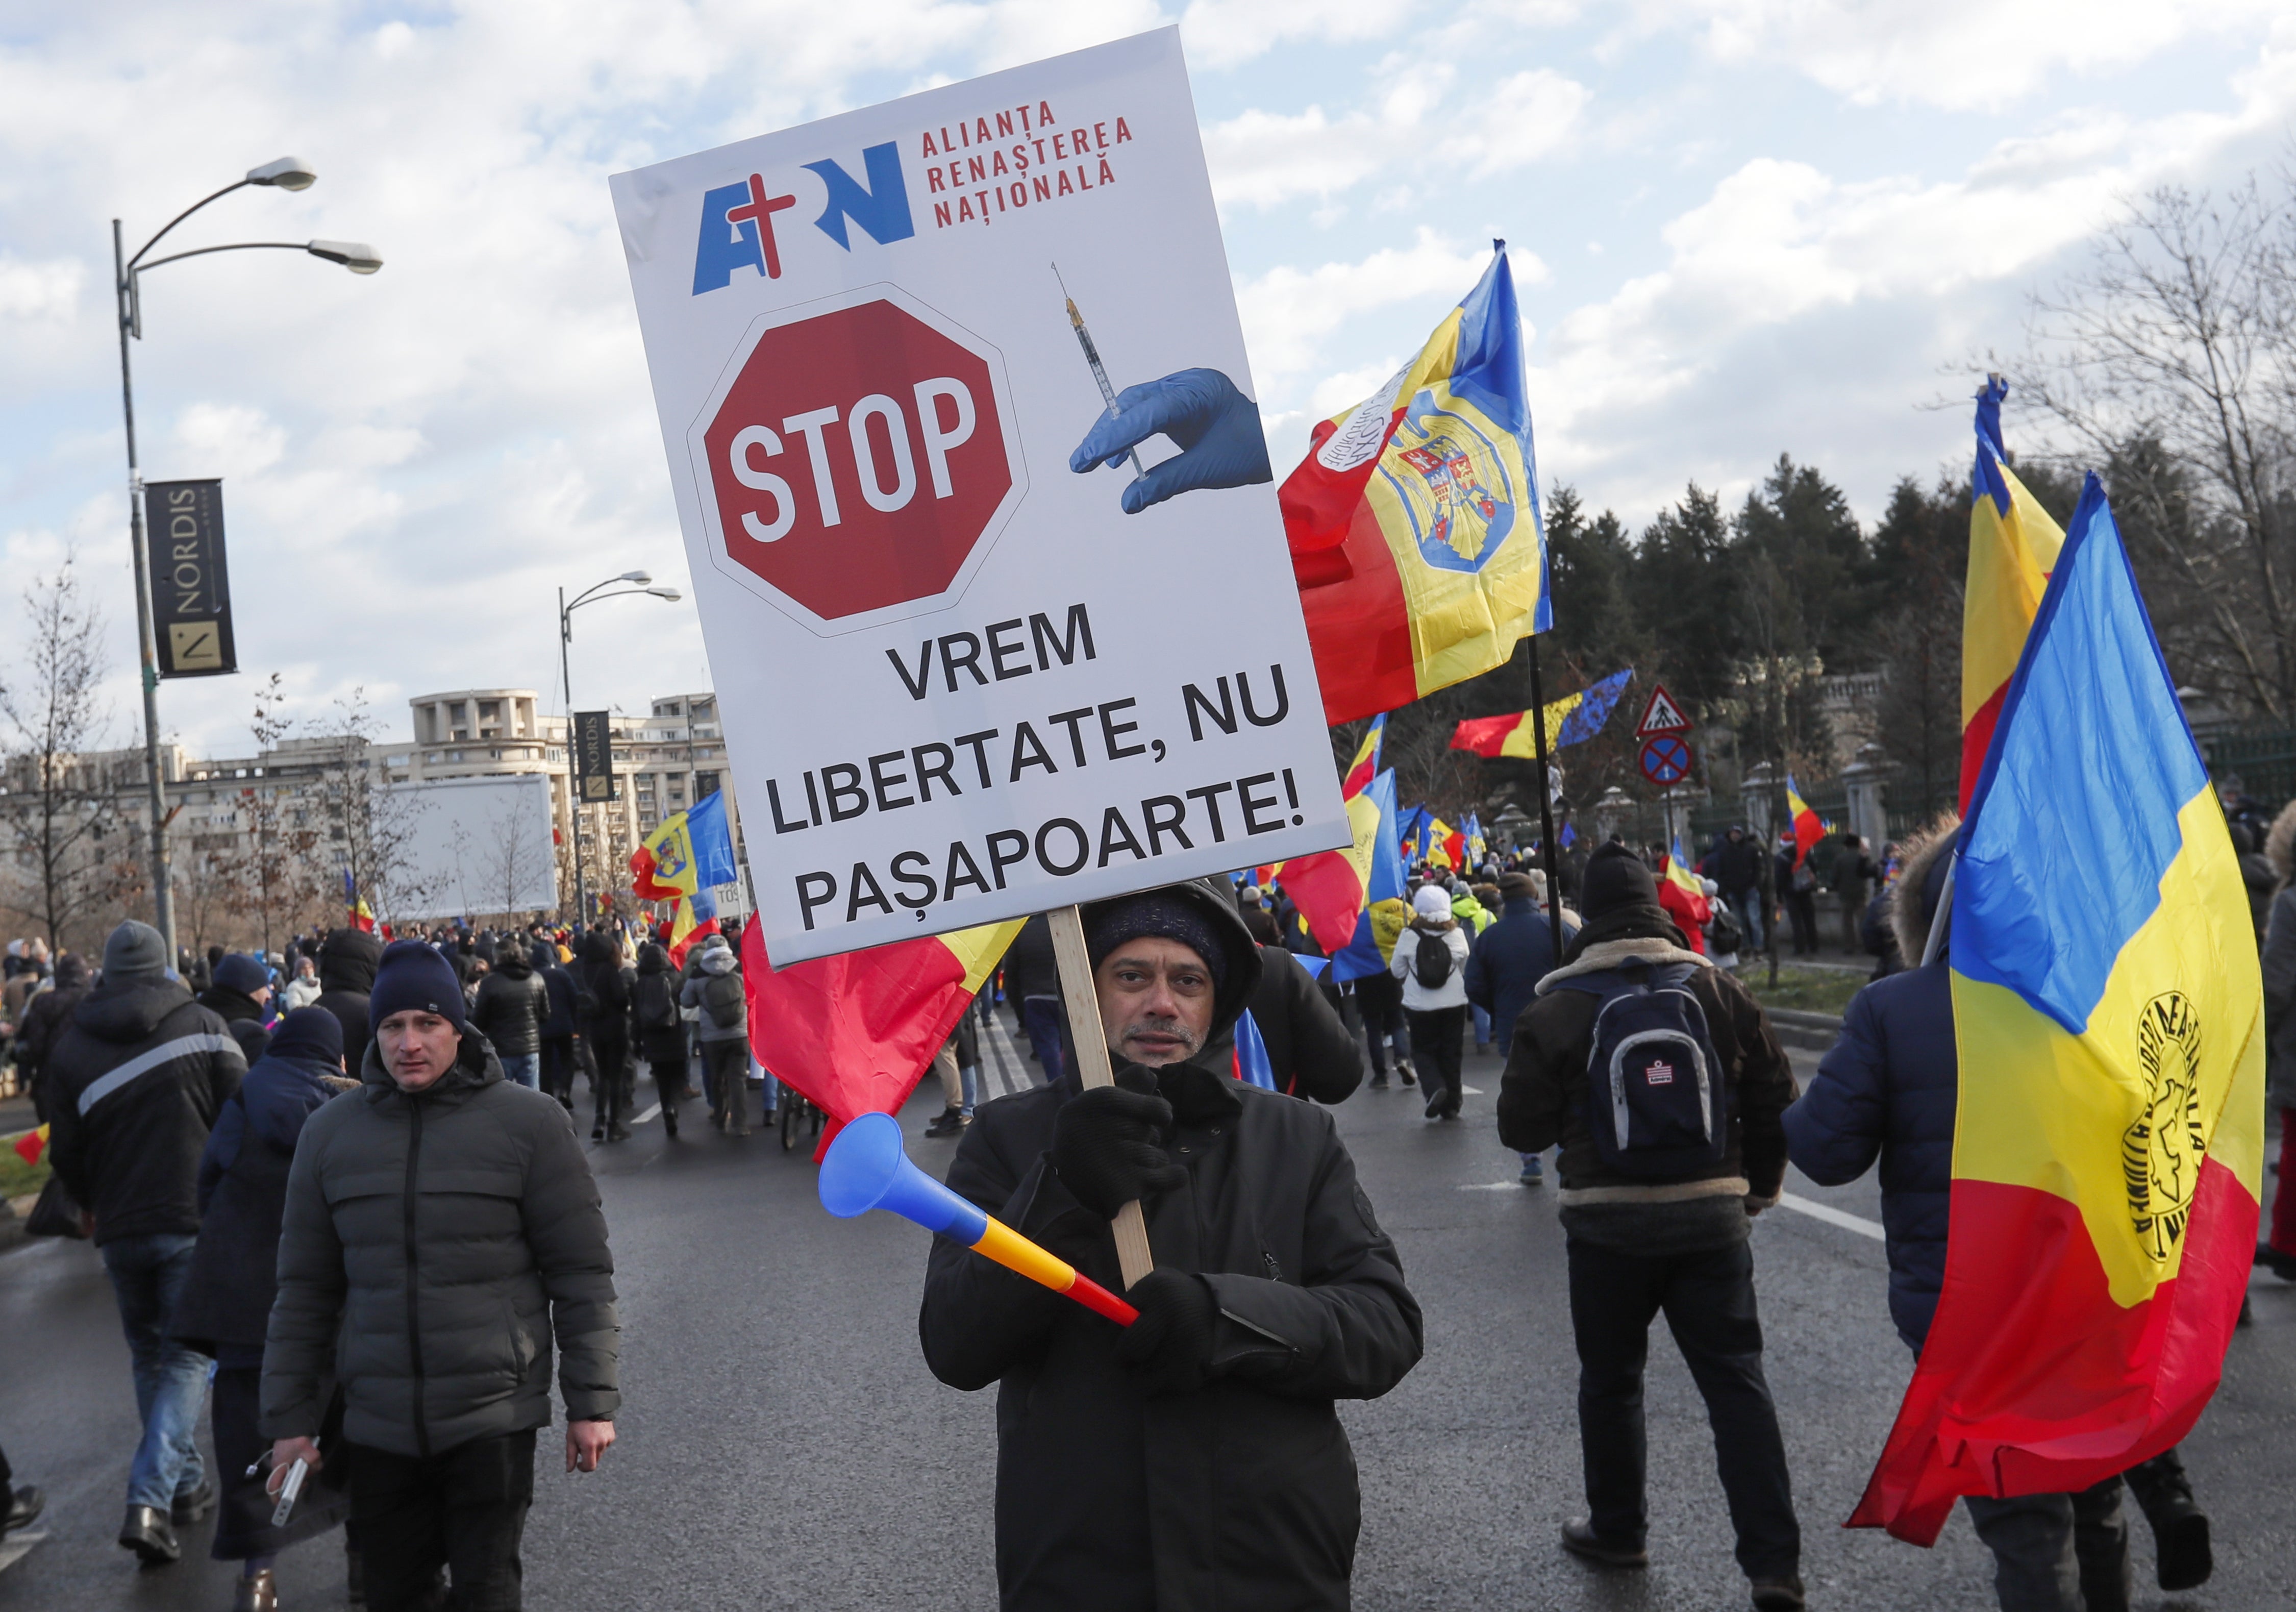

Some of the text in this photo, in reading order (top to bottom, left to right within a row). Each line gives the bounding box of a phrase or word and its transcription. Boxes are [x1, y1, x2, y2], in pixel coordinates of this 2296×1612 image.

[922, 100, 1056, 158] ALIANȚA
[927, 117, 1133, 193] RENAȘTEREA
[934, 154, 1116, 228] NAȚIONALĂ
[730, 376, 978, 543] STOP
[168, 488, 203, 614] NORDIS
[885, 603, 1097, 701] VREM
[585, 716, 600, 775] NORDIS
[765, 663, 1289, 835] LIBERTATE, NU
[794, 768, 1305, 931] PAȘAPOARTE!
